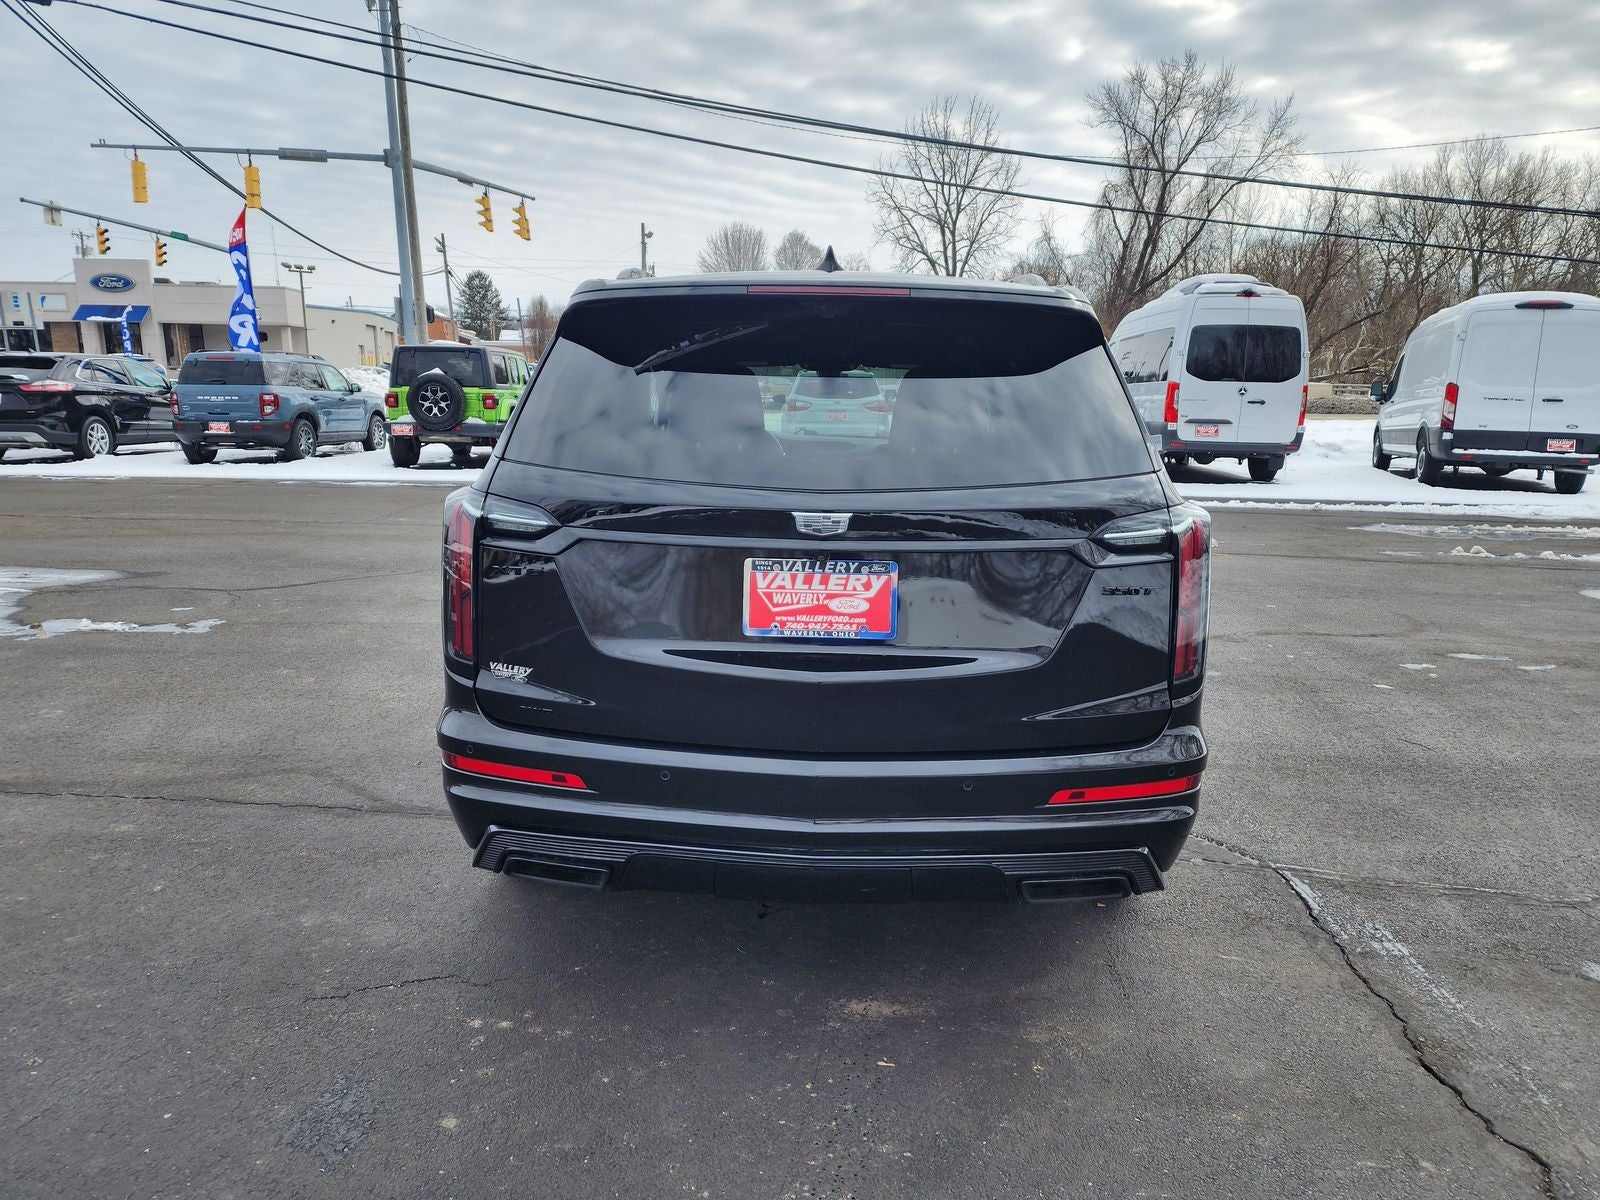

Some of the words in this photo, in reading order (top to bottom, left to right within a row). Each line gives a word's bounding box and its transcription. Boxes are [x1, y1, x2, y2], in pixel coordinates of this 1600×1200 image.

[98, 276, 124, 287] Ford
[782, 560, 859, 573] VALLERY
[755, 572, 889, 596] VALLERY
[772, 592, 826, 605] WAVERLY
[775, 614, 866, 624] www.VALLERYFORD.com
[784, 622, 857, 630] 740-947-7565
[489, 661, 534, 677] VALLERY
